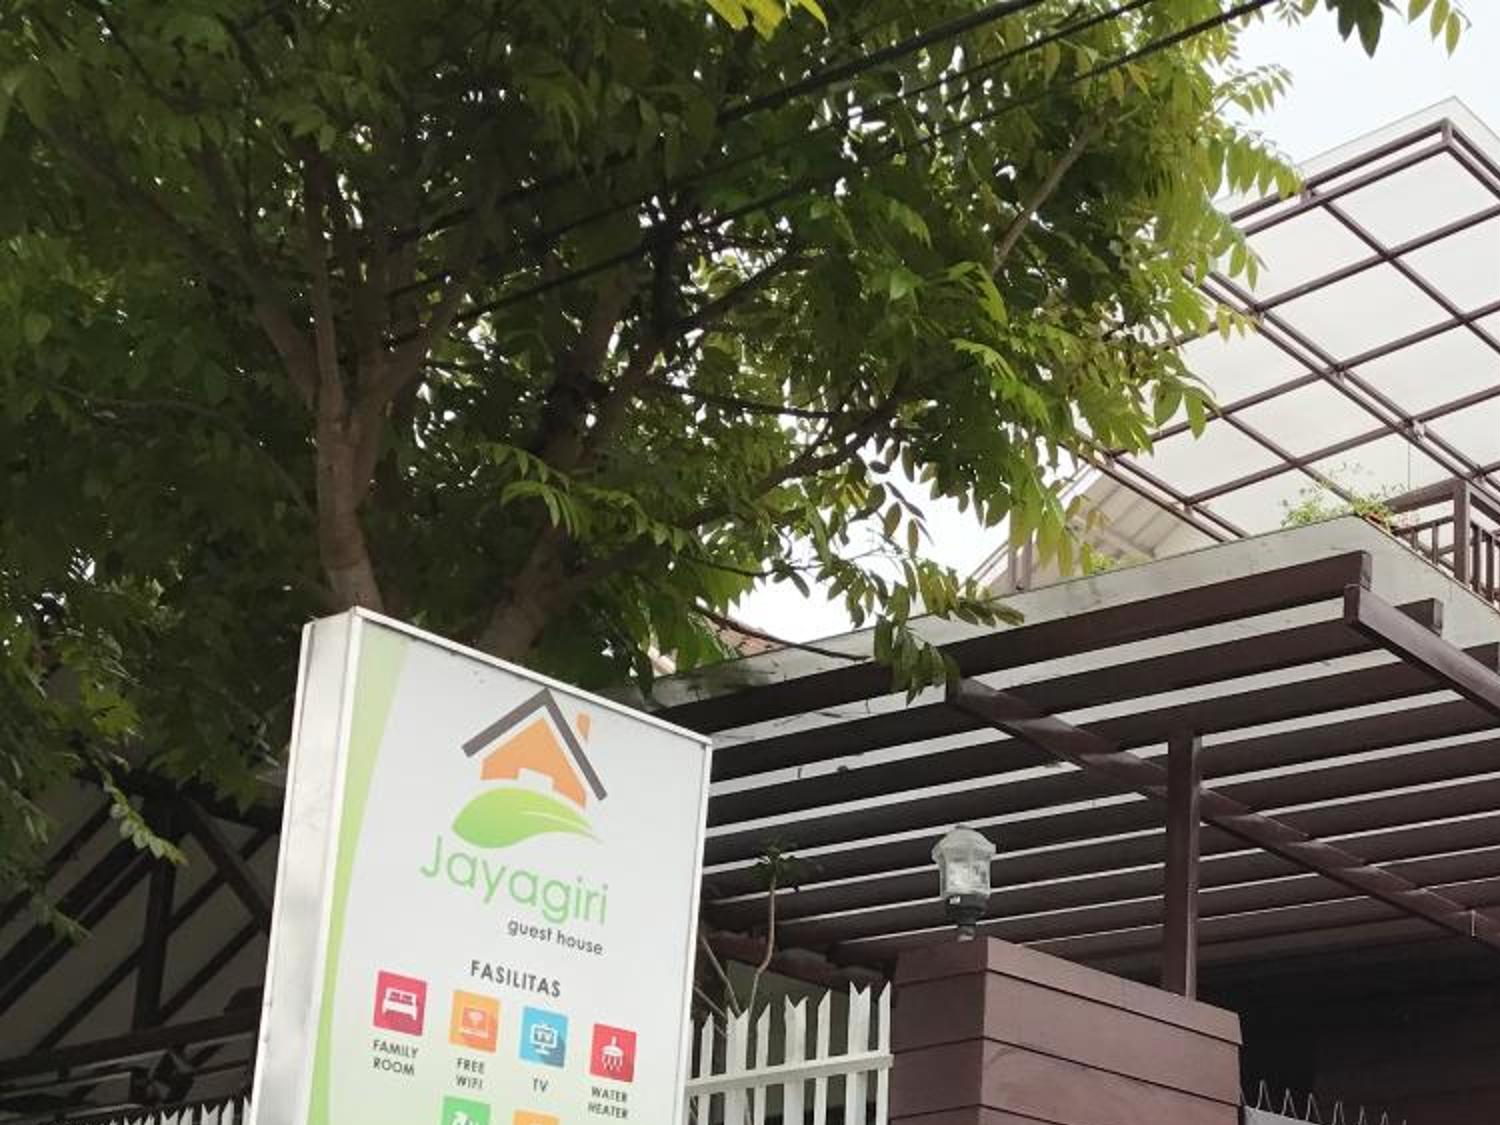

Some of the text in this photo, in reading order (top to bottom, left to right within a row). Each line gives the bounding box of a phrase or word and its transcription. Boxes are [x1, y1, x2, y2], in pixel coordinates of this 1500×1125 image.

[420, 834, 608, 925] Jayagiri
[507, 919, 603, 954] guest house
[471, 960, 561, 997] FASILITAS
[373, 1039, 418, 1059] FAMILY
[373, 1058, 415, 1076] ROOM
[457, 1057, 485, 1075] FREE
[456, 1075, 483, 1090] WIFI
[532, 1077, 549, 1093] TV
[591, 1086, 628, 1103] WATER
[588, 1102, 628, 1119] HEATER
